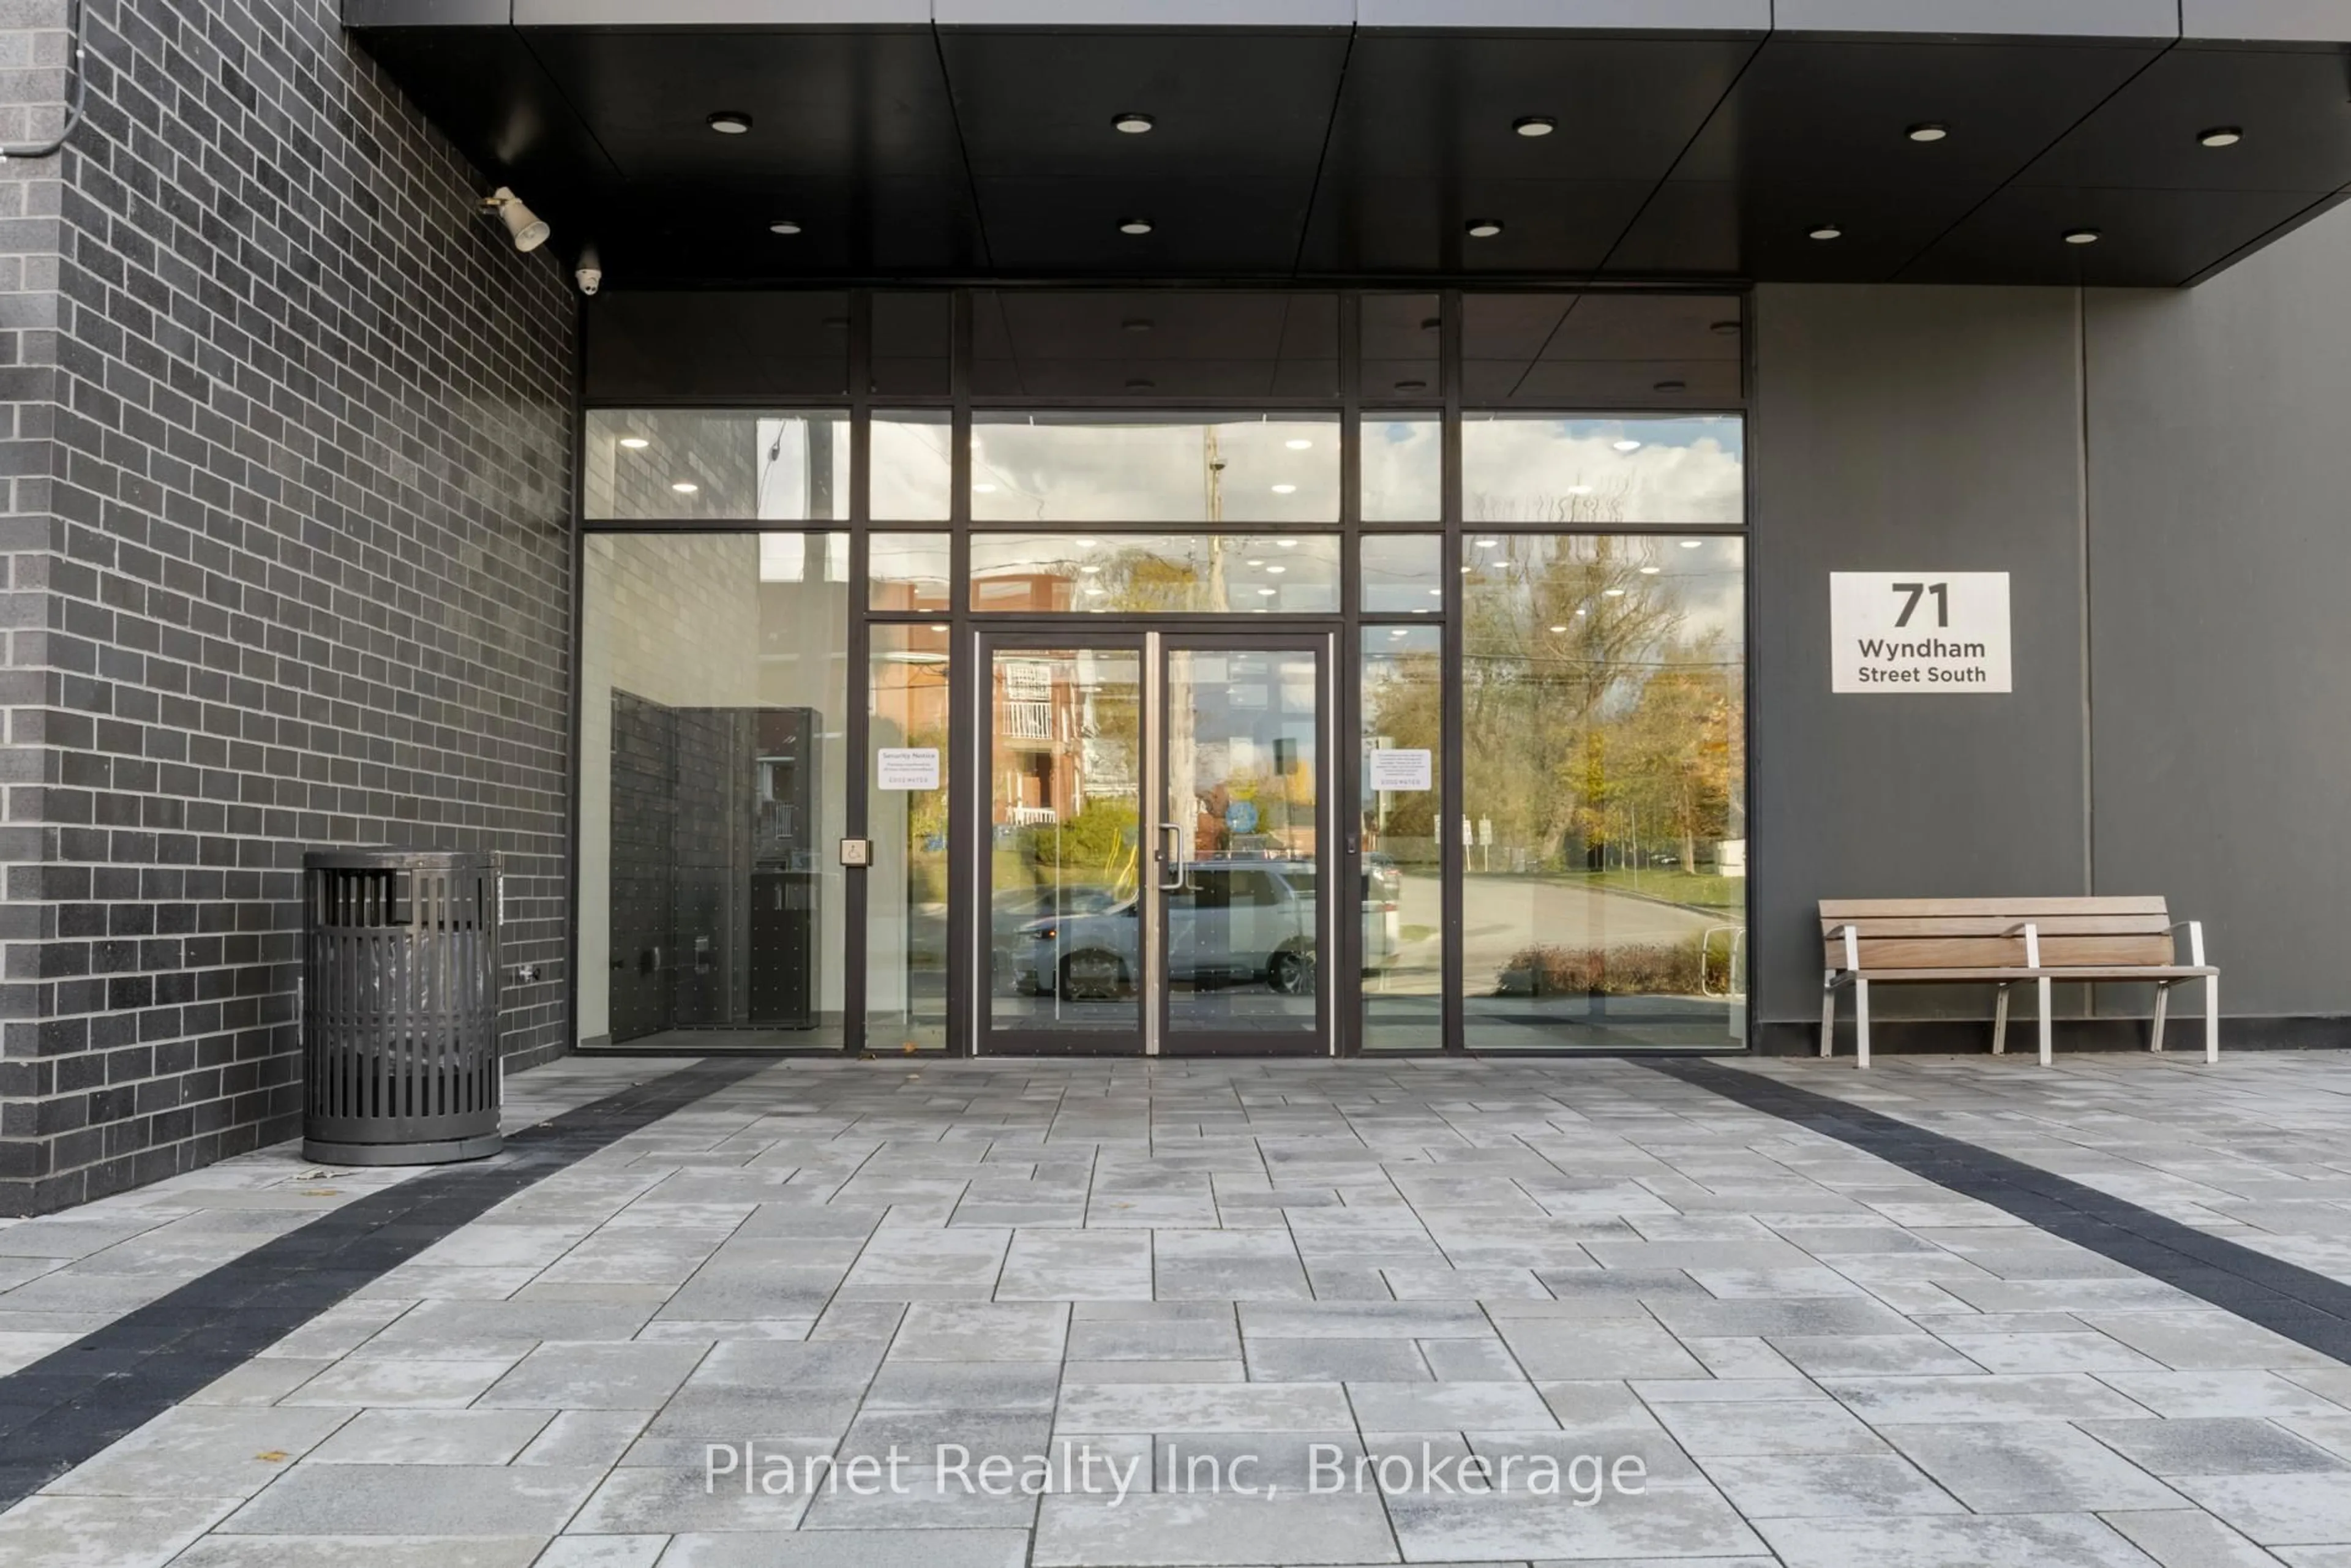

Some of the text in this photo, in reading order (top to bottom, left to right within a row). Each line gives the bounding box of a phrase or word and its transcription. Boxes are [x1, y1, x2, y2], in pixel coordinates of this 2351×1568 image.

[1892, 583, 1948, 627] 71
[1858, 639, 1985, 661] Wyndham
[1858, 667, 1986, 682] Street South
